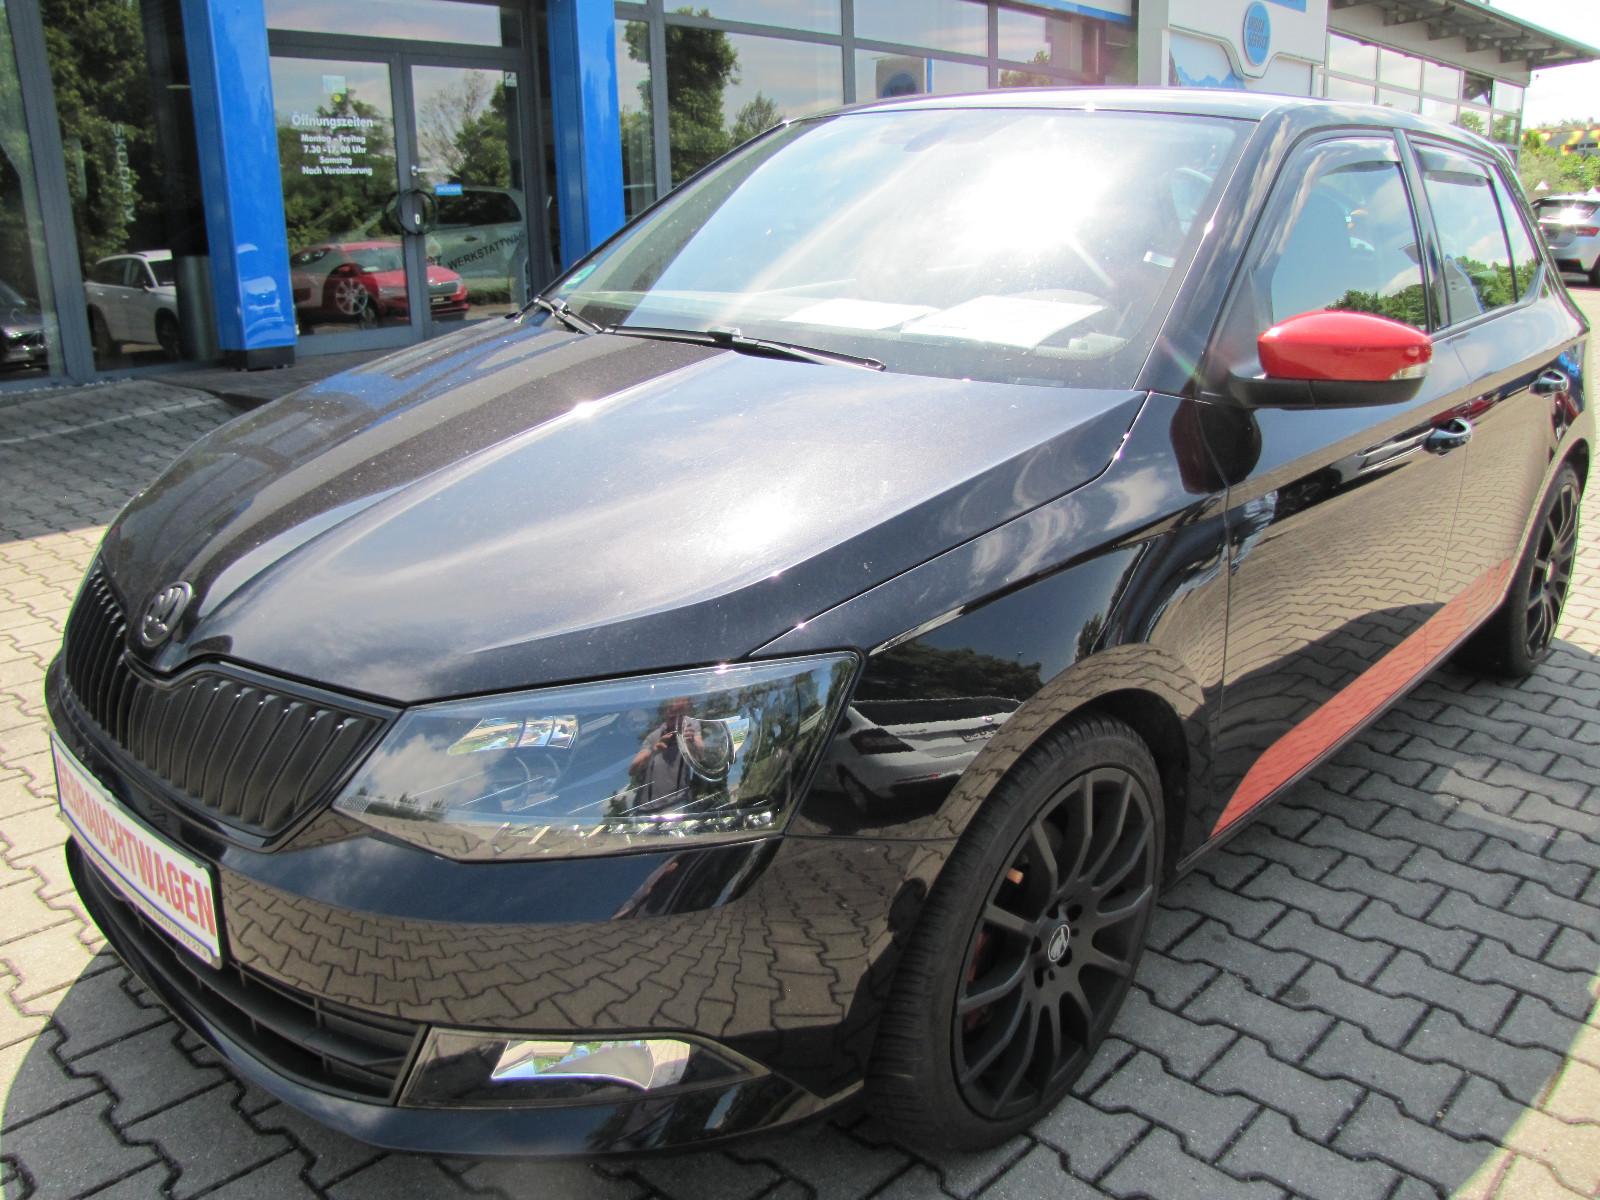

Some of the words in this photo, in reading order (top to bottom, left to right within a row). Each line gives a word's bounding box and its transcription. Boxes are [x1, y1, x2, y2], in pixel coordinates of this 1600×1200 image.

[291, 112, 374, 129] Öffnungszeiten
[301, 134, 332, 144] Montag
[340, 134, 366, 145] Freitag
[352, 145, 367, 154] Uhr
[319, 156, 352, 165] Samstag
[302, 165, 322, 175] Nach
[322, 166, 373, 176] Vereinbarung
